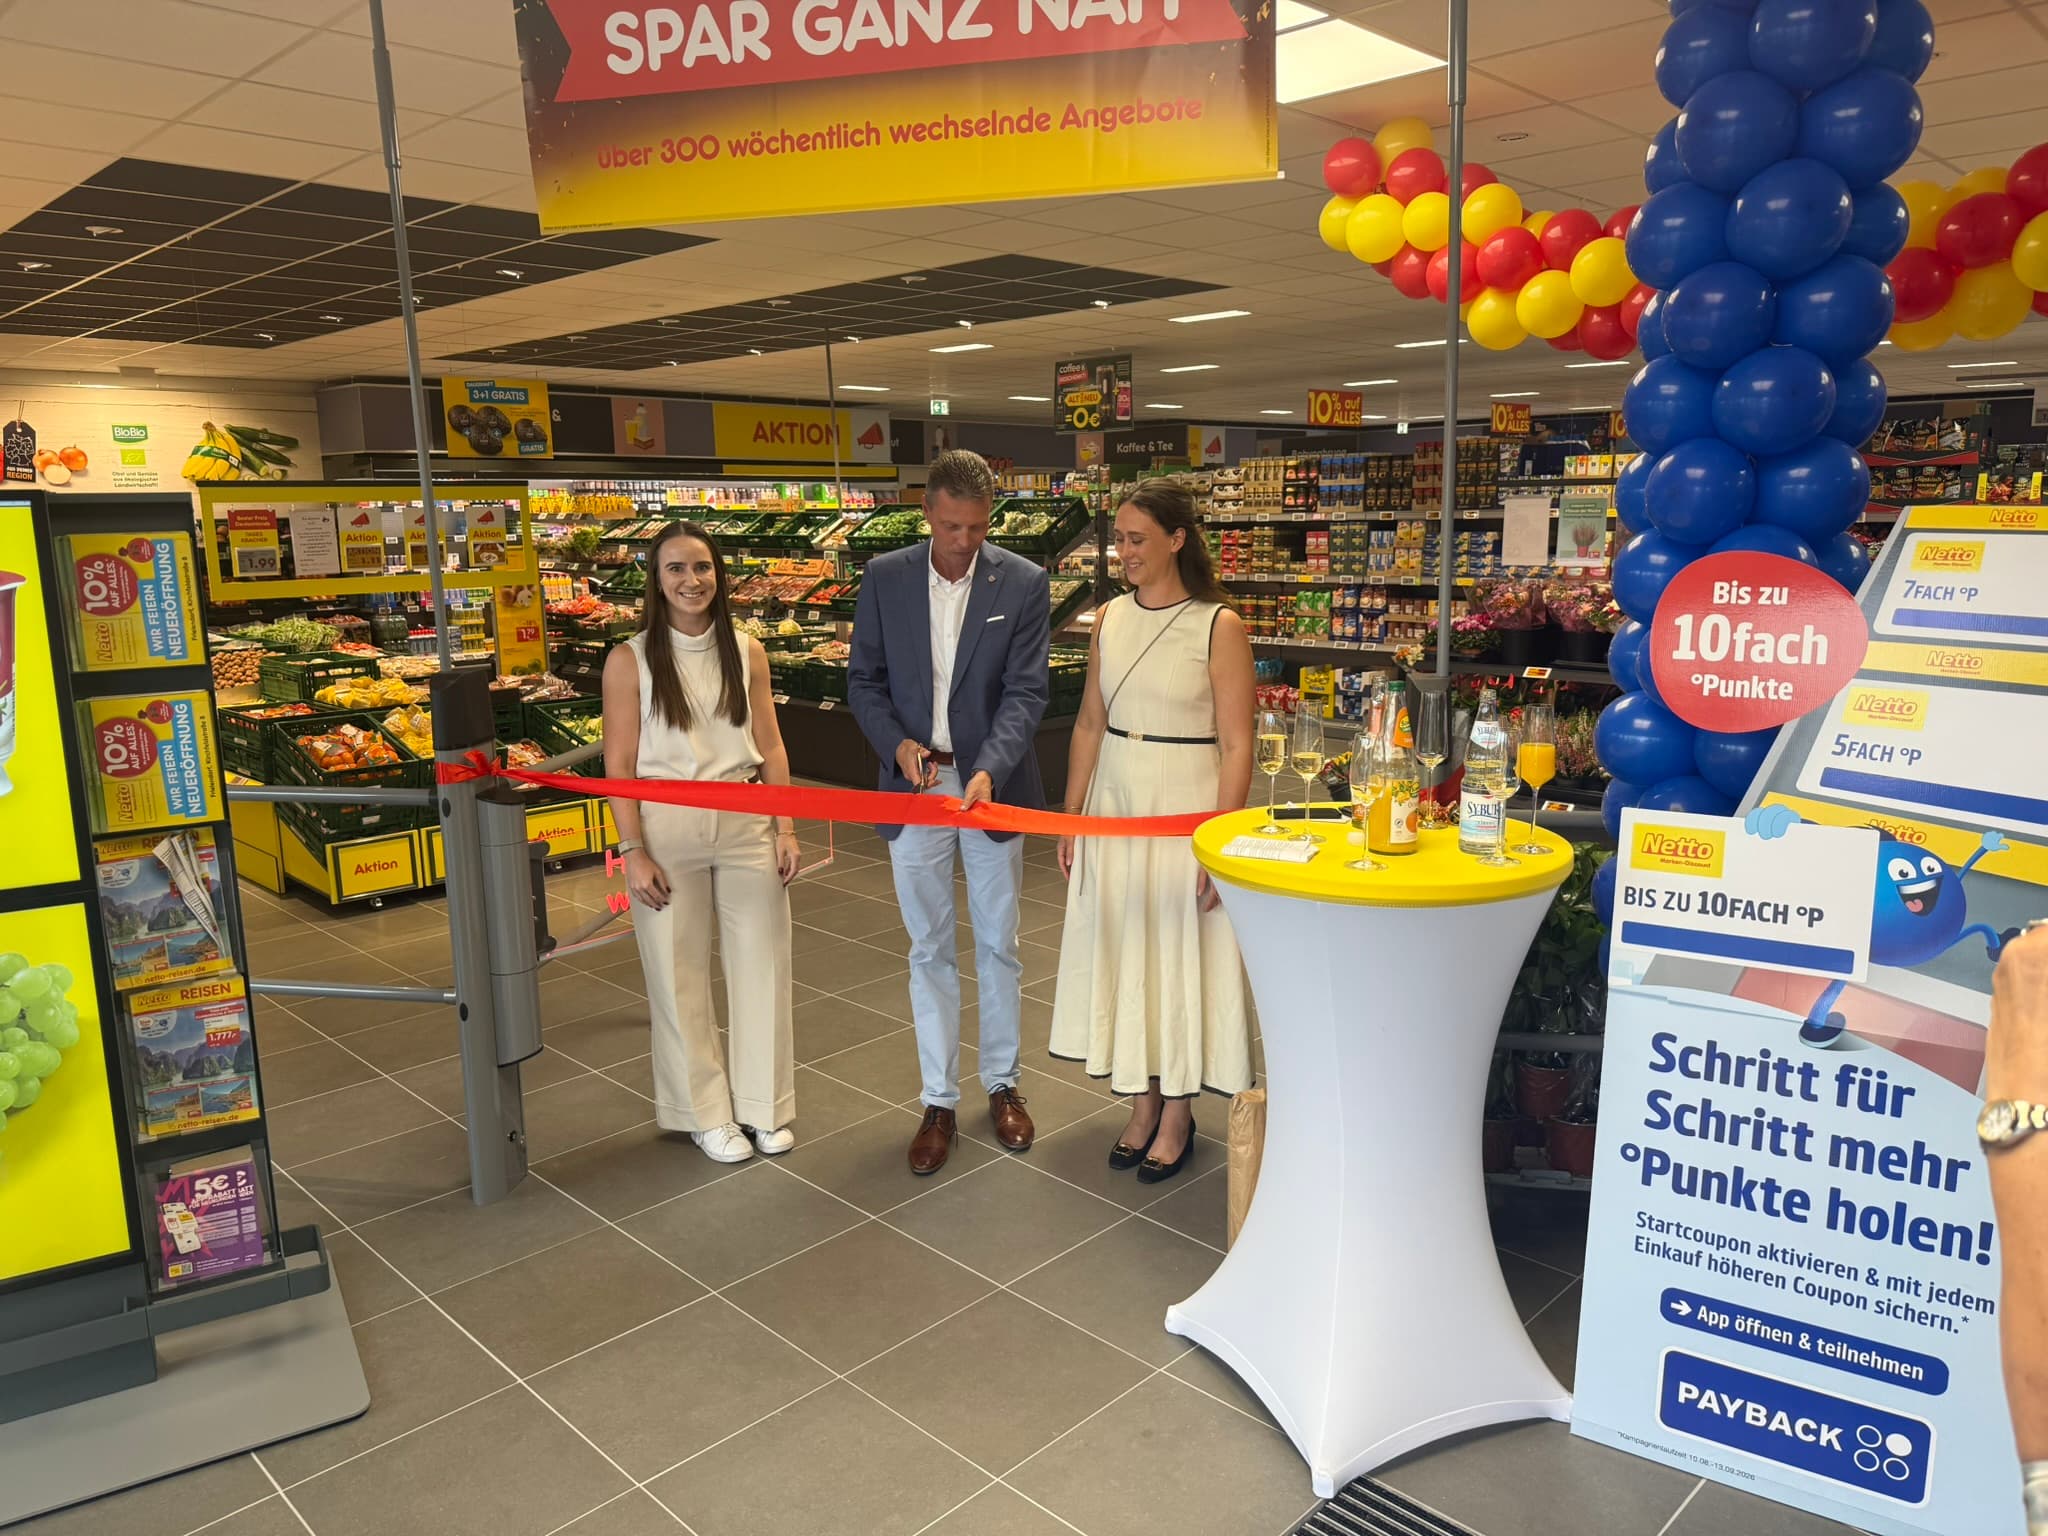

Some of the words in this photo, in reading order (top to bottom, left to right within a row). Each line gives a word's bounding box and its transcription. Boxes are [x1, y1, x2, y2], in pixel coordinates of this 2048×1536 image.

[604, 0, 771, 75] SPAR
[792, 0, 993, 56] GANZ
[598, 142, 653, 169] über
[660, 134, 720, 164] 300
[728, 120, 881, 158] wöchentlich
[889, 107, 1052, 144] wechselnde
[1060, 96, 1202, 133] Angebote
[473, 390, 489, 399] 3+1
[491, 391, 526, 401] GRATIS
[1345, 397, 1360, 409] auf
[1333, 411, 1360, 424] ALLES
[1508, 420, 1530, 432] ALLES
[752, 420, 840, 446] AKTION
[1117, 442, 1145, 454] Kaffee
[1149, 441, 1155, 451] &
[1157, 441, 1174, 451] Tee
[7, 471, 33, 481] REGION
[1989, 508, 2038, 523] Netto
[346, 533, 378, 542] Aktion
[473, 530, 502, 540] Aktion
[248, 558, 276, 569] 1.99
[1920, 546, 1976, 561] Netto
[82, 560, 110, 612] 10%
[1713, 580, 1751, 605] Bis
[1758, 587, 1789, 605] zu
[1902, 579, 1954, 602] 7FACH
[108, 590, 121, 608] AUF
[143, 584, 160, 625] FEIERN
[156, 543, 183, 656] NEUERÖFFNUNG
[151, 628, 164, 651] WIR
[1672, 613, 1828, 665] 10fach
[1926, 650, 1982, 669] Netto
[1854, 694, 1918, 715] Netto
[103, 724, 130, 774] 10%
[129, 752, 141, 769] AUF
[174, 703, 202, 814] NEUERÖFFNUNG
[1831, 733, 1894, 763] 5FACH
[162, 745, 178, 784] FEIERN
[170, 787, 184, 810] WIR
[537, 826, 575, 842] Aktion
[1641, 832, 1713, 860] Netto
[354, 859, 398, 876] Aktion
[1624, 886, 1656, 908] BIS
[1663, 891, 1690, 912] ZU
[1697, 891, 1789, 925] 10FACH
[180, 982, 232, 1000] REISEN
[1649, 1032, 1820, 1102] Schritt
[1835, 1064, 1916, 1118] für
[1644, 1089, 1814, 1162] Schritt
[1828, 1132, 1971, 1193] mehr
[194, 1174, 230, 1201] 5€
[1826, 1186, 1994, 1266] holen!
[1634, 1235, 1704, 1271] Einkauf
[1707, 1251, 1787, 1290] höheren
[1793, 1276, 1868, 1313] Coupon
[1635, 1210, 1752, 1257] Startcoupon
[1757, 1243, 1859, 1282] aktivieren
[1866, 1267, 1880, 1287] &
[1886, 1274, 1922, 1297] mit
[1926, 1281, 1996, 1315] jedem
[1697, 1305, 1730, 1333] App
[1734, 1313, 1794, 1346] öffnen
[1798, 1333, 1811, 1350] &
[1816, 1337, 1924, 1382] teilnehmen
[1677, 1380, 1844, 1452] PAYBACK
